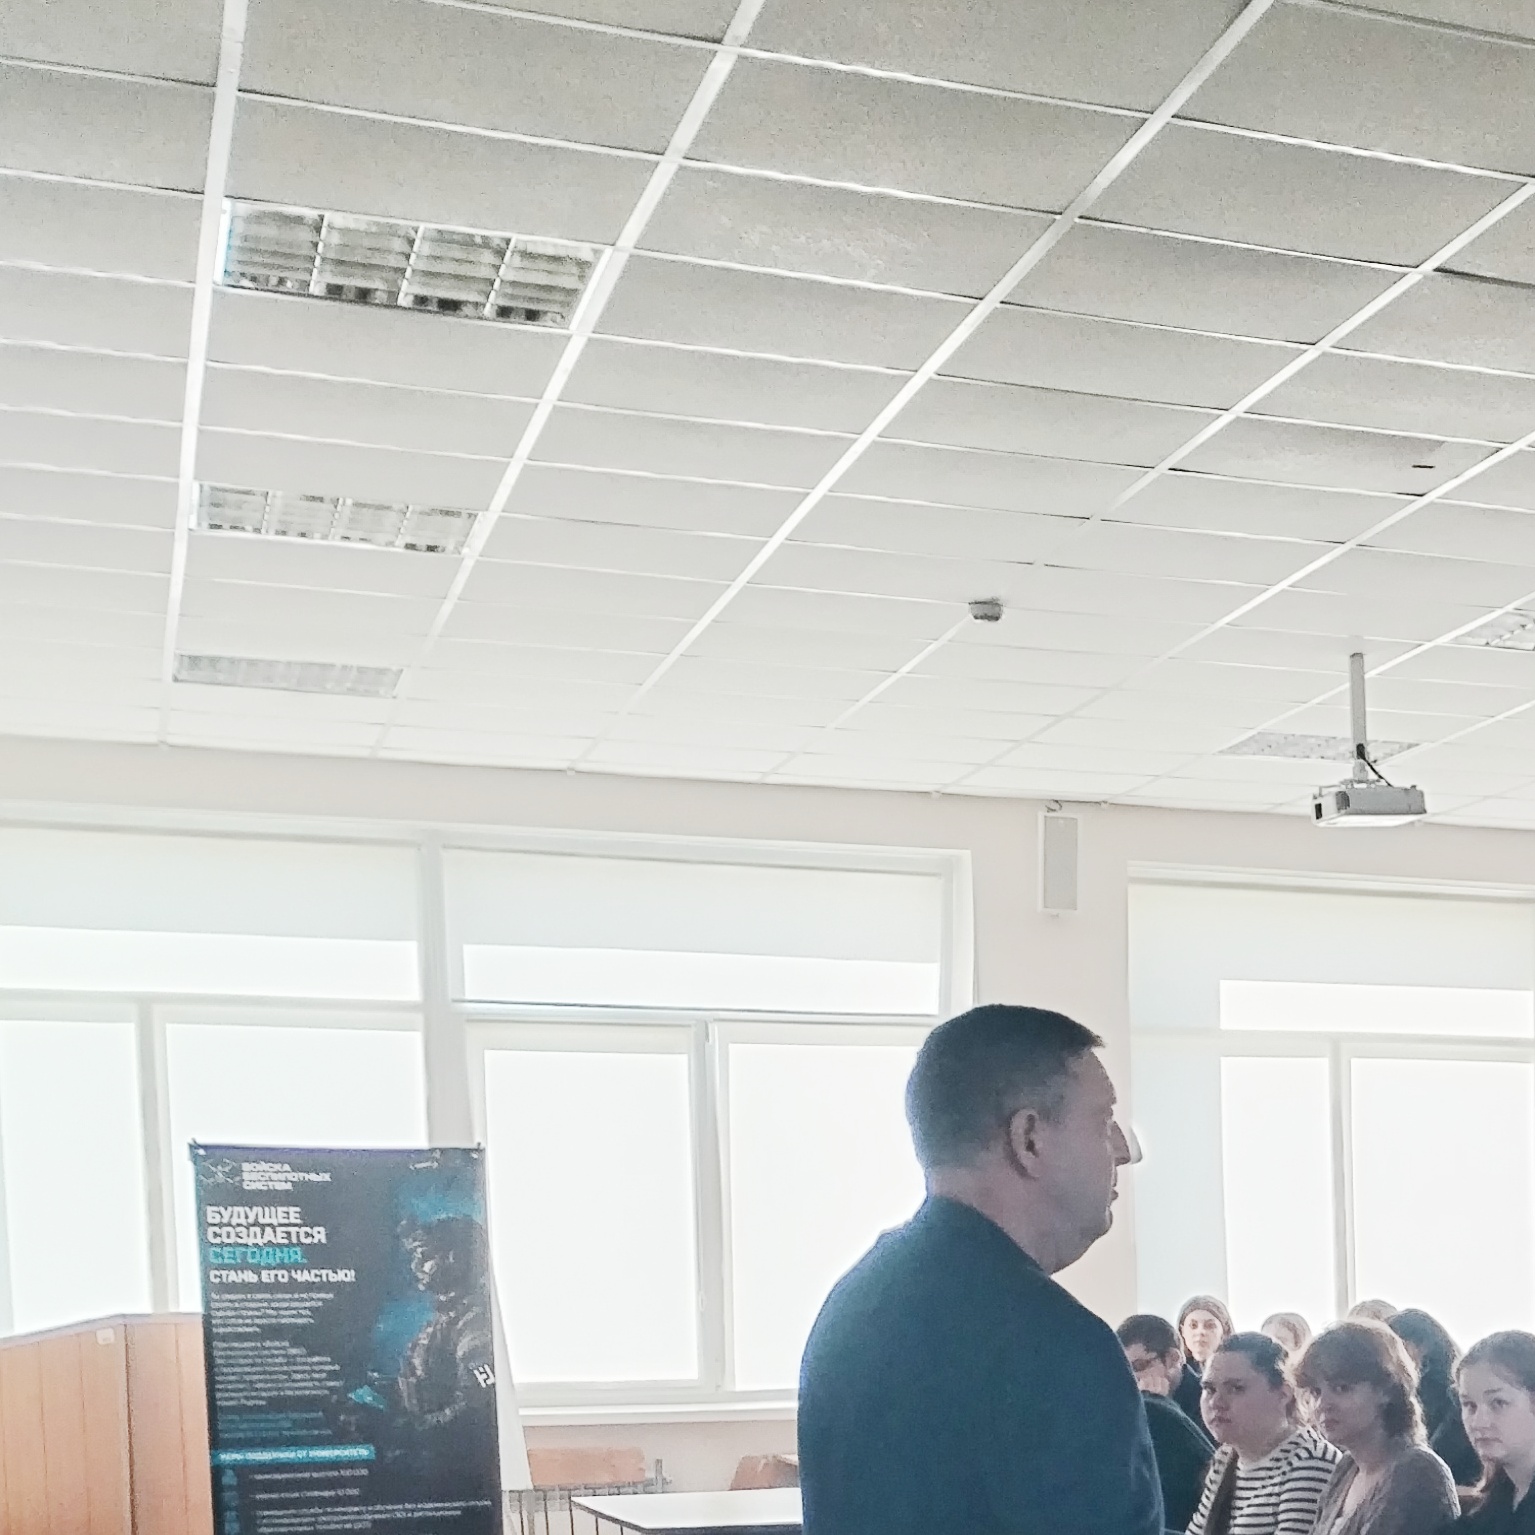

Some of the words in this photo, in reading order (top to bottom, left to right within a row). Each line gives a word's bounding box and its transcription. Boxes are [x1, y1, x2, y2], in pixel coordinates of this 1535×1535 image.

[206, 1205, 302, 1226] БУДУЩЕЕ
[206, 1226, 327, 1246] СОЗДАЕТСЯ
[209, 1247, 307, 1266] СЕГОДНЯ.
[209, 1269, 259, 1284] СТАНЬ
[260, 1269, 290, 1283] ЕГО
[291, 1268, 356, 1283] ЧАСТЬЮ!
